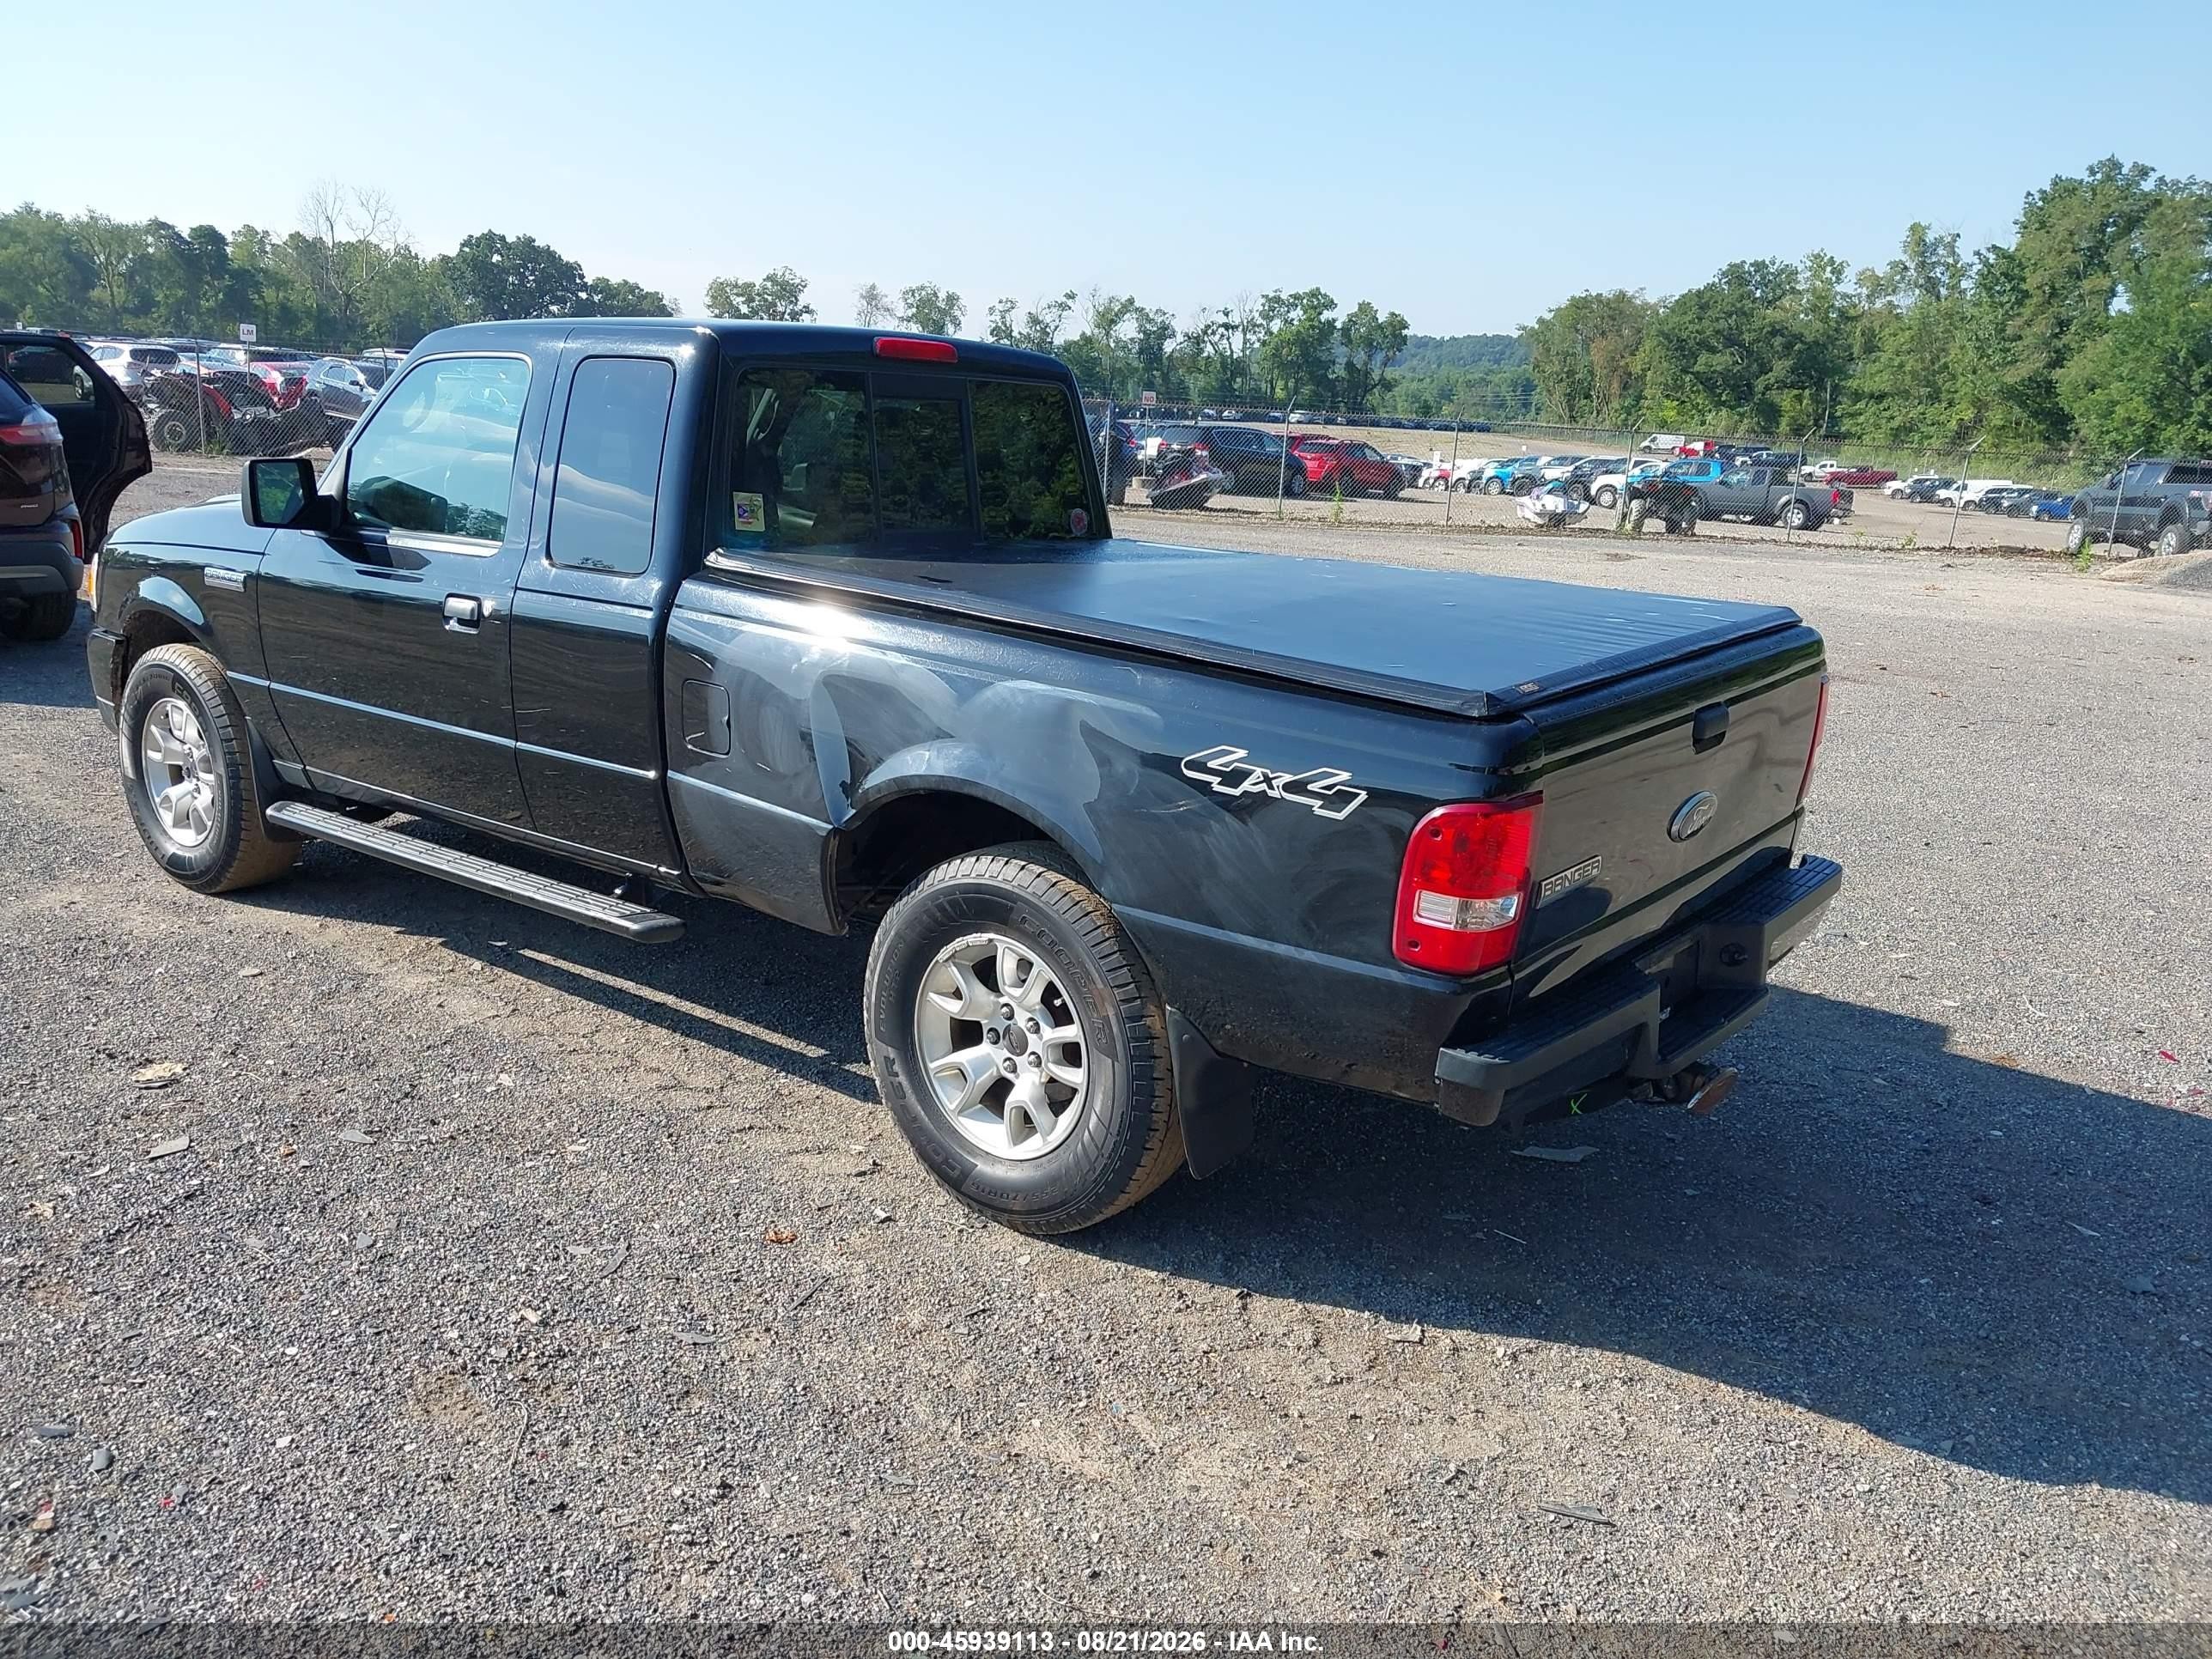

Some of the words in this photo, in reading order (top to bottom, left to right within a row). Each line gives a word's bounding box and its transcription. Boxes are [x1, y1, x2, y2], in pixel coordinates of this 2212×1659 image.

[205, 568, 243, 583] RANGER
[1181, 744, 1369, 821] 4x4
[1543, 859, 1600, 897] RANGER
[879, 939, 905, 1033] EVOLUTION
[1018, 914, 1109, 1046] COOPER
